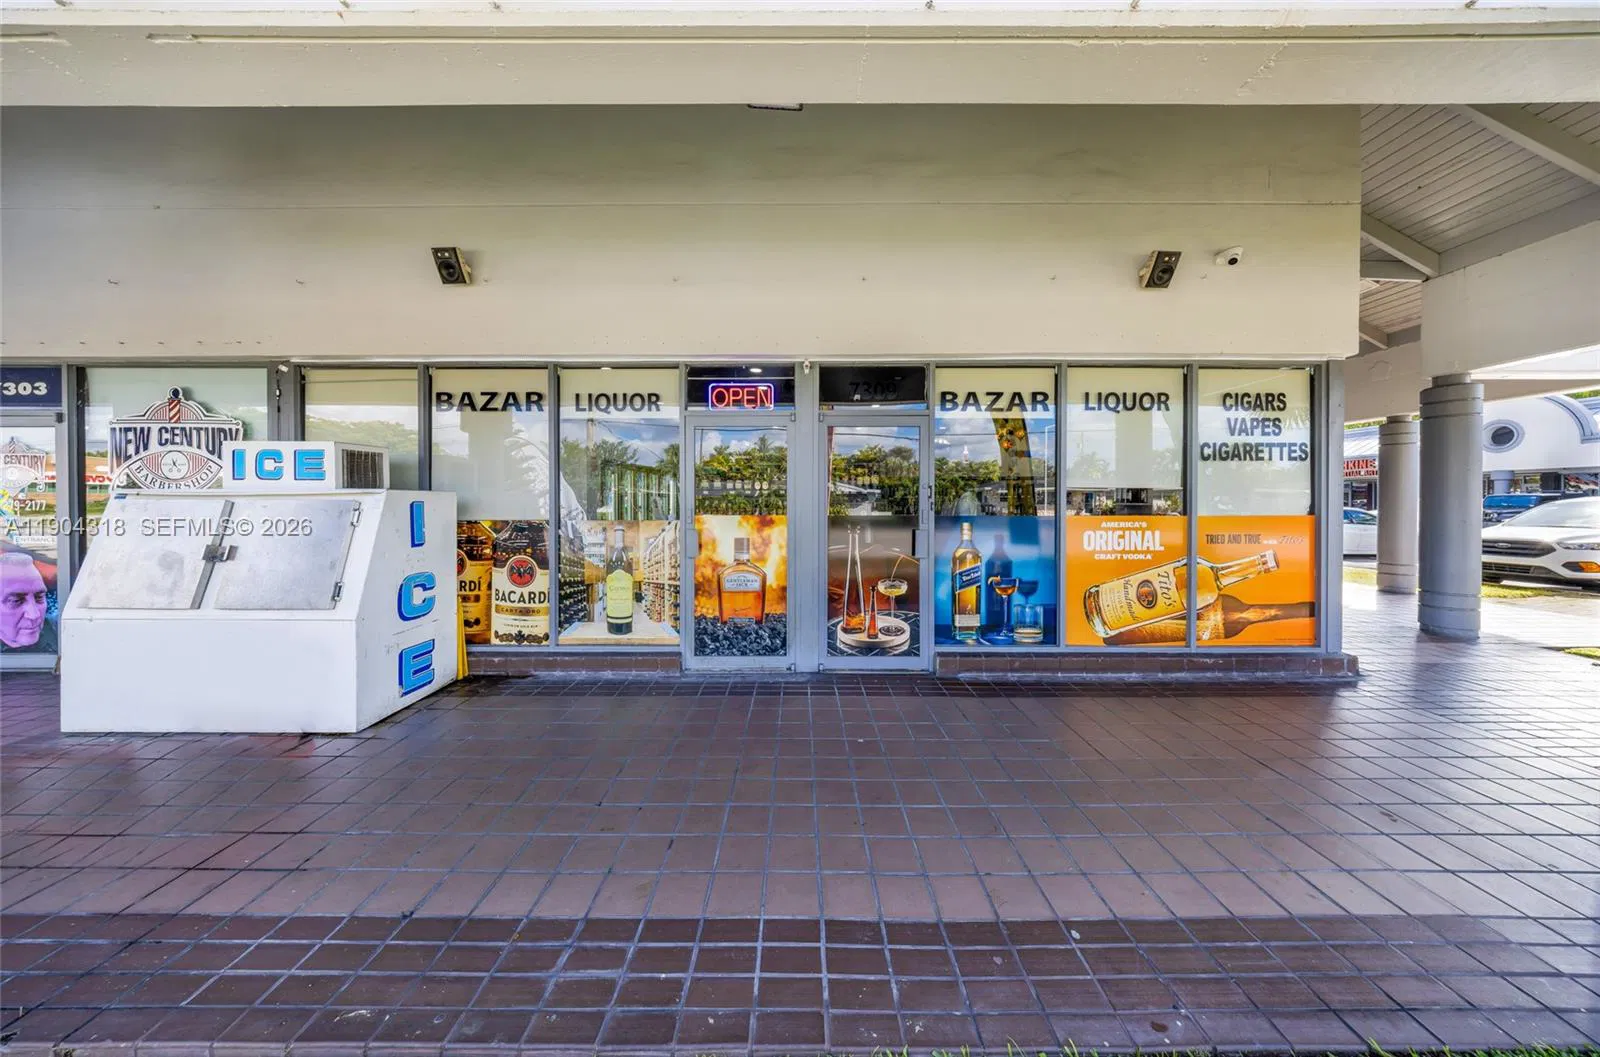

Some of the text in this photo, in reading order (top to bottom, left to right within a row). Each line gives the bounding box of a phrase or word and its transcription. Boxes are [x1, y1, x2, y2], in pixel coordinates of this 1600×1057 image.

[0, 382, 48, 396] 303
[712, 388, 772, 408] OPEN
[435, 391, 544, 412] BAZAR
[575, 392, 661, 414] LIQUOR
[940, 391, 1049, 412] BAZAR
[1084, 392, 1170, 413] LIQUOR
[1222, 392, 1286, 412] CIGARS
[1227, 417, 1282, 437] VAPES
[110, 426, 151, 473] NEW
[1200, 442, 1309, 462] CIGARETTES
[4, 454, 45, 472] CENTURY
[232, 449, 326, 480] ICE
[134, 464, 214, 489] BARBERSHOP
[1083, 530, 1164, 551] ORIGINAL
[1205, 534, 1225, 544] TRIED
[1227, 534, 1242, 544] AND
[1243, 534, 1261, 544] TRUE
[459, 576, 482, 592] RDÍ
[1157, 571, 1177, 609] Tito's
[397, 501, 436, 697] ICE
[1123, 579, 1140, 621] Handmad
